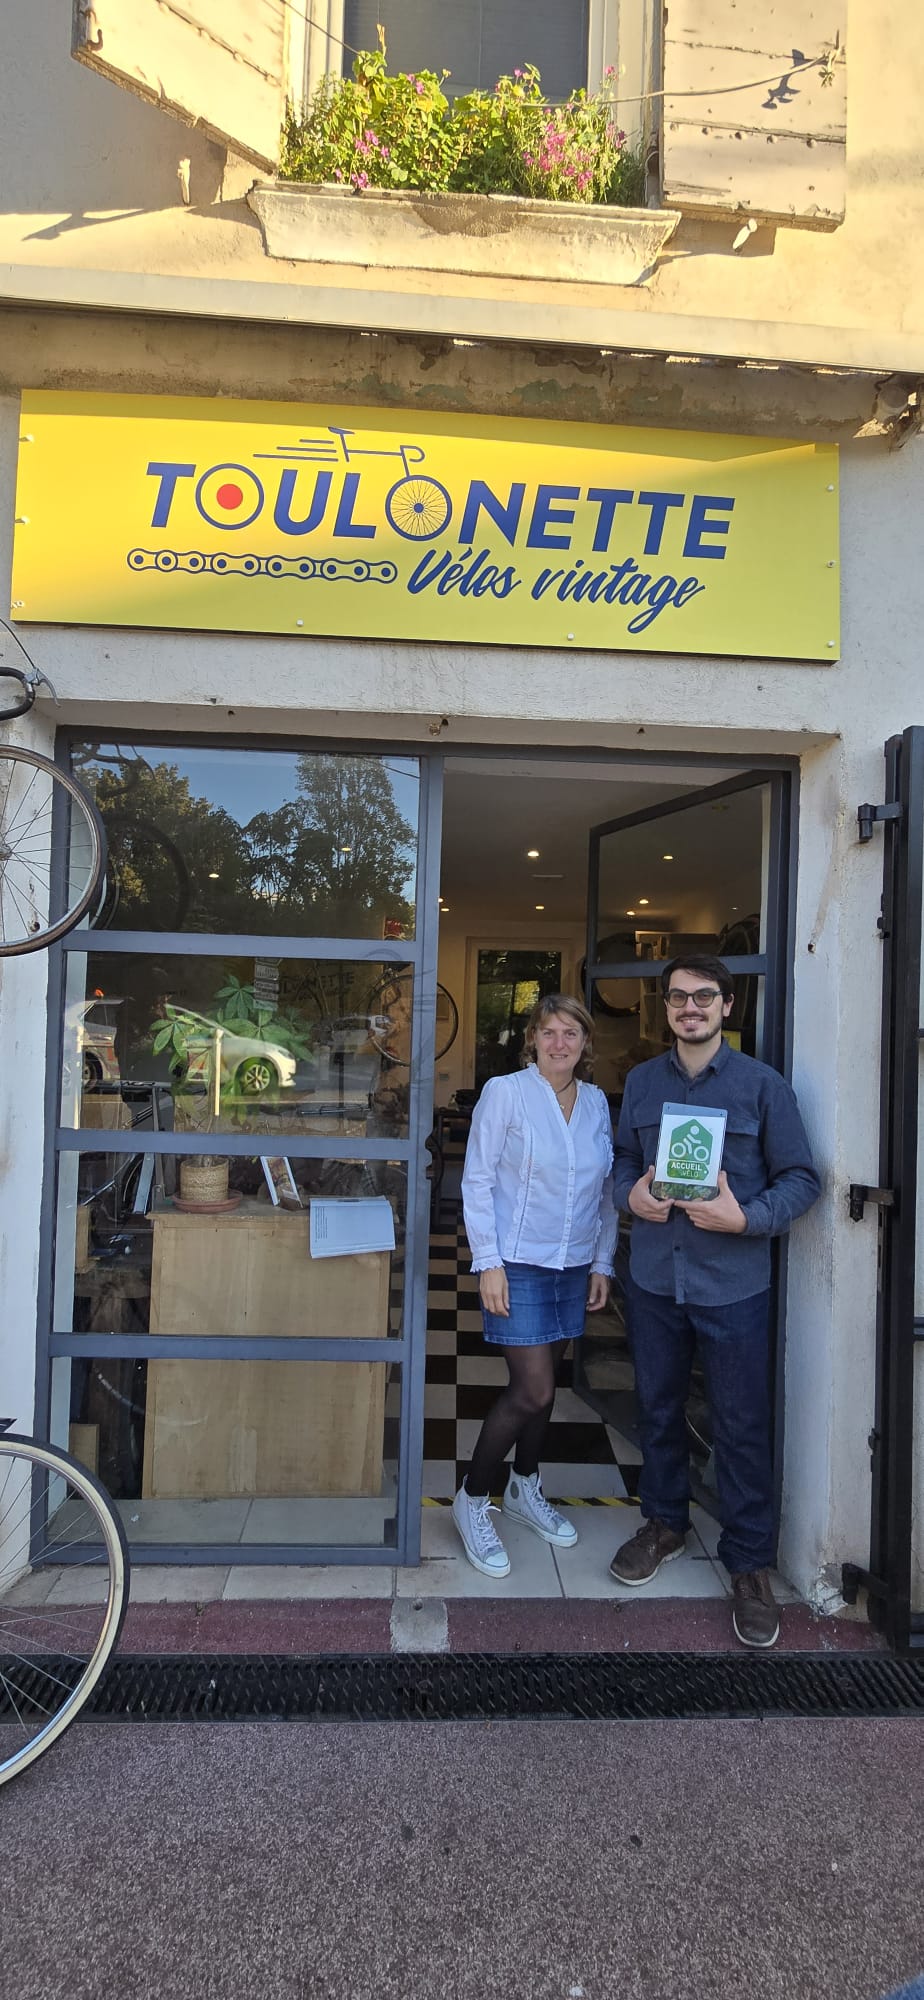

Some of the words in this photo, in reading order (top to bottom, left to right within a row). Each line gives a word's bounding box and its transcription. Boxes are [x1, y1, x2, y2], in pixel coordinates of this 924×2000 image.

[146, 462, 735, 559] TOULONETTE
[407, 547, 521, 598] Vélos
[531, 557, 705, 633] vintage
[671, 1161, 703, 1171] ACCUEIL
